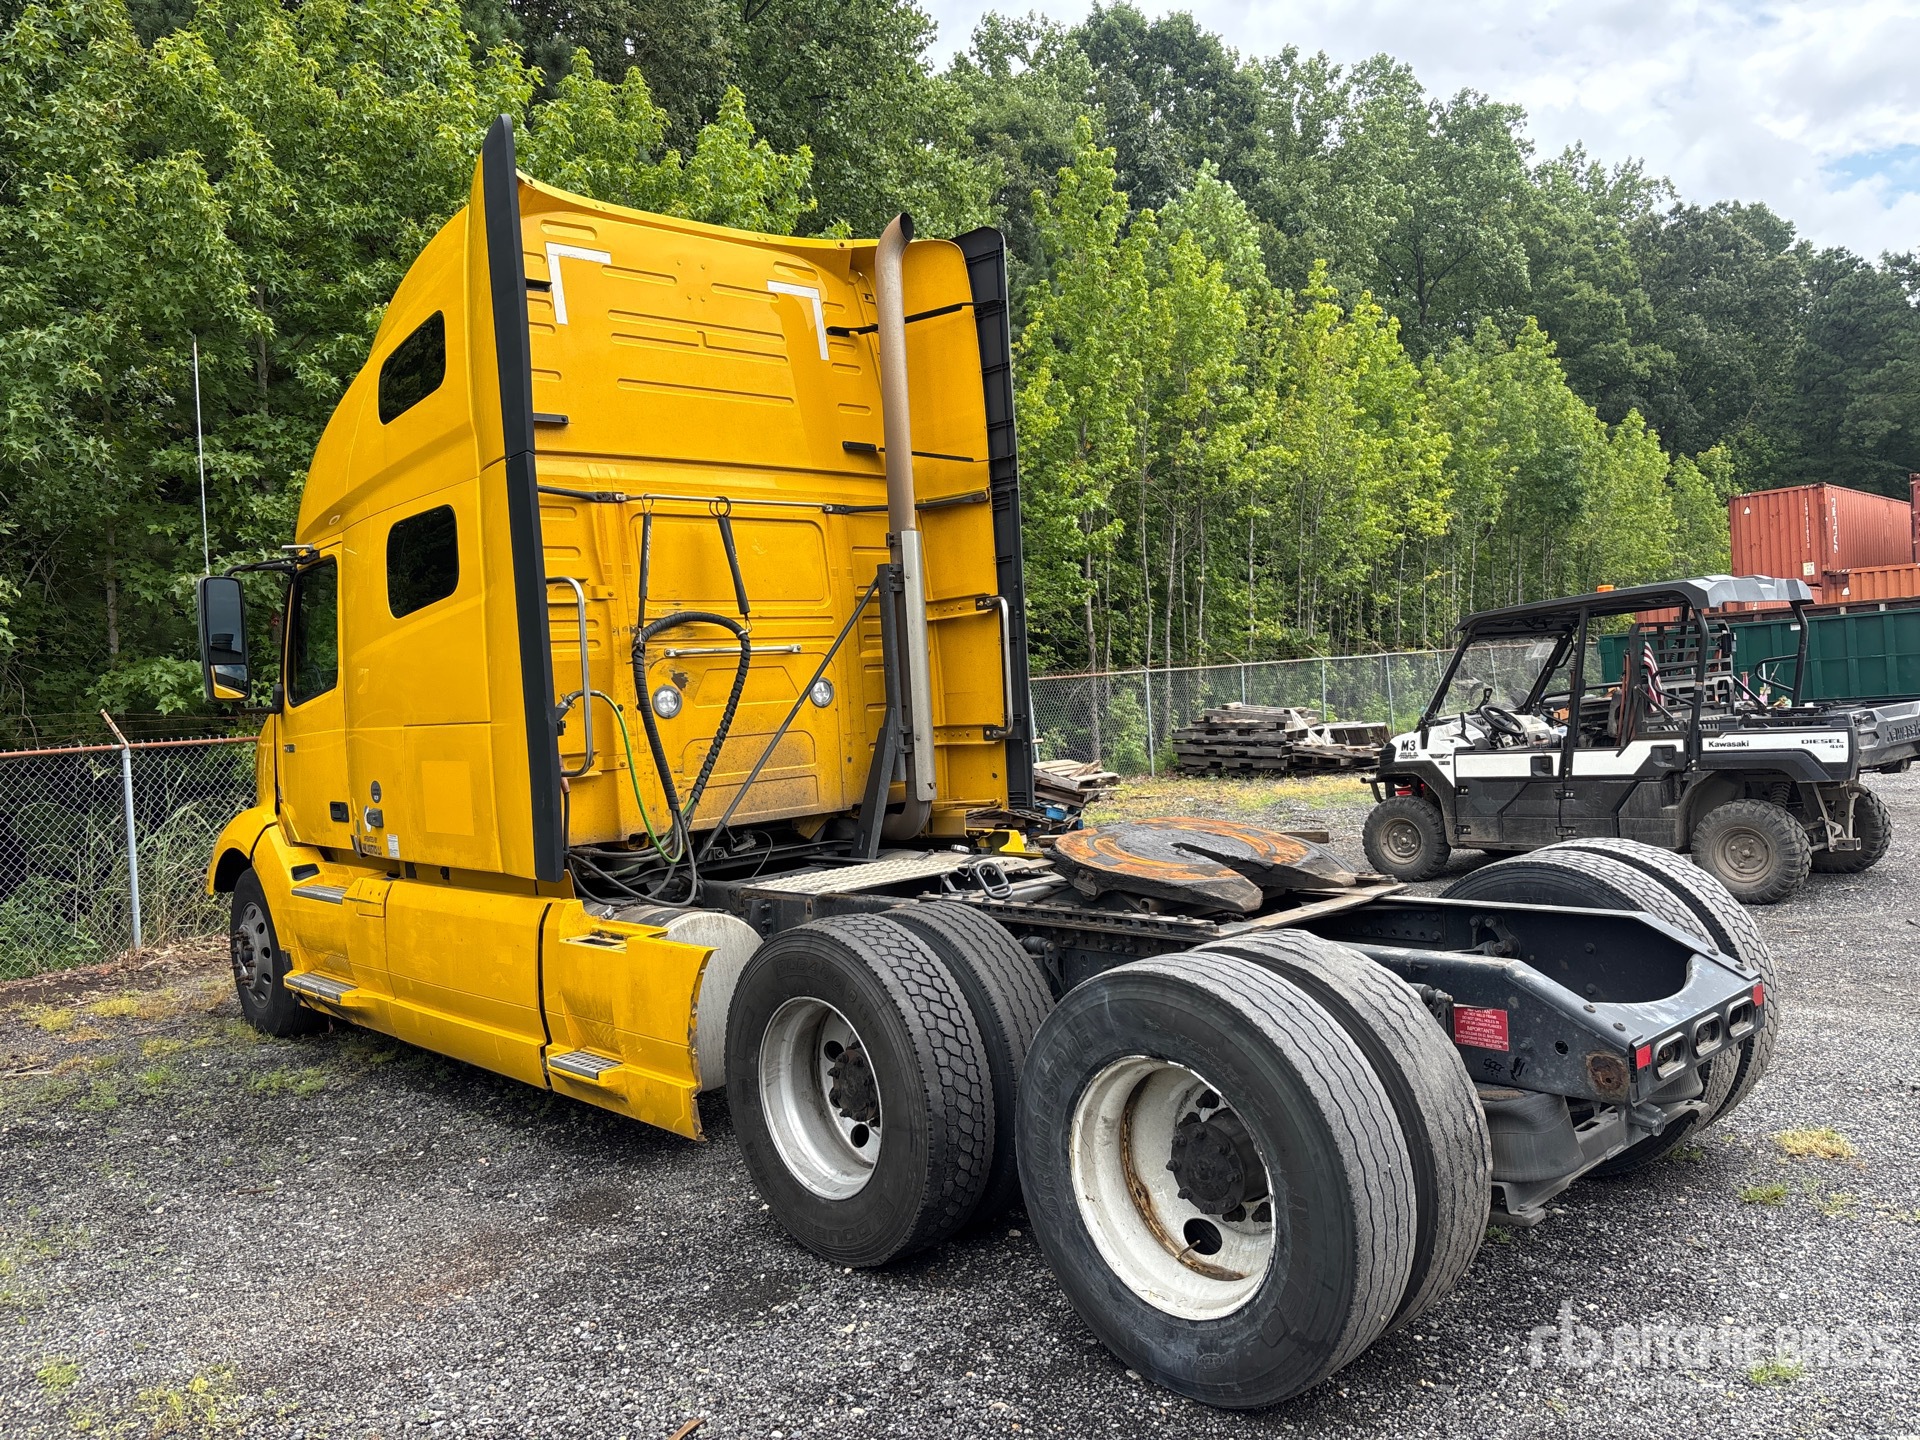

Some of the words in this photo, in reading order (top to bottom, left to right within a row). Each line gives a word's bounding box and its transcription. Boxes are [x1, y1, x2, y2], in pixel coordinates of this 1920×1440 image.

[1401, 740, 1416, 751] M3
[1708, 740, 1749, 748] Kawasaki
[1466, 1025, 1495, 1034] IMPORTANTE
[1036, 1022, 1095, 1221] BRIDGESTONE
